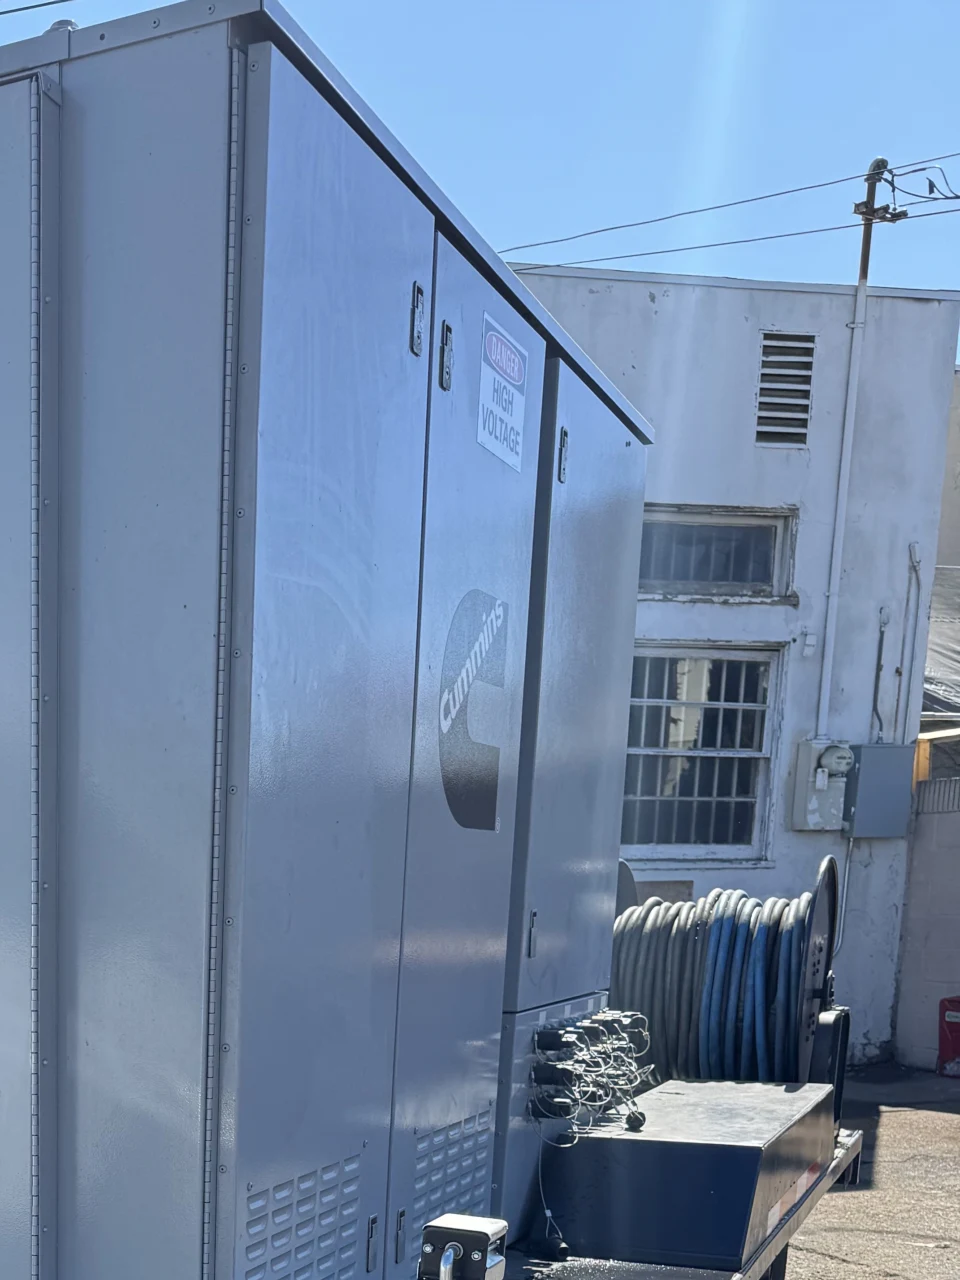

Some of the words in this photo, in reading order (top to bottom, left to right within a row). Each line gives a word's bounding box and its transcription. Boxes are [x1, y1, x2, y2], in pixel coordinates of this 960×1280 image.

[491, 335, 519, 381] DANGER
[492, 376, 514, 417] HIGH
[481, 403, 520, 457] VOLTAGE
[440, 600, 504, 734] Cummins
